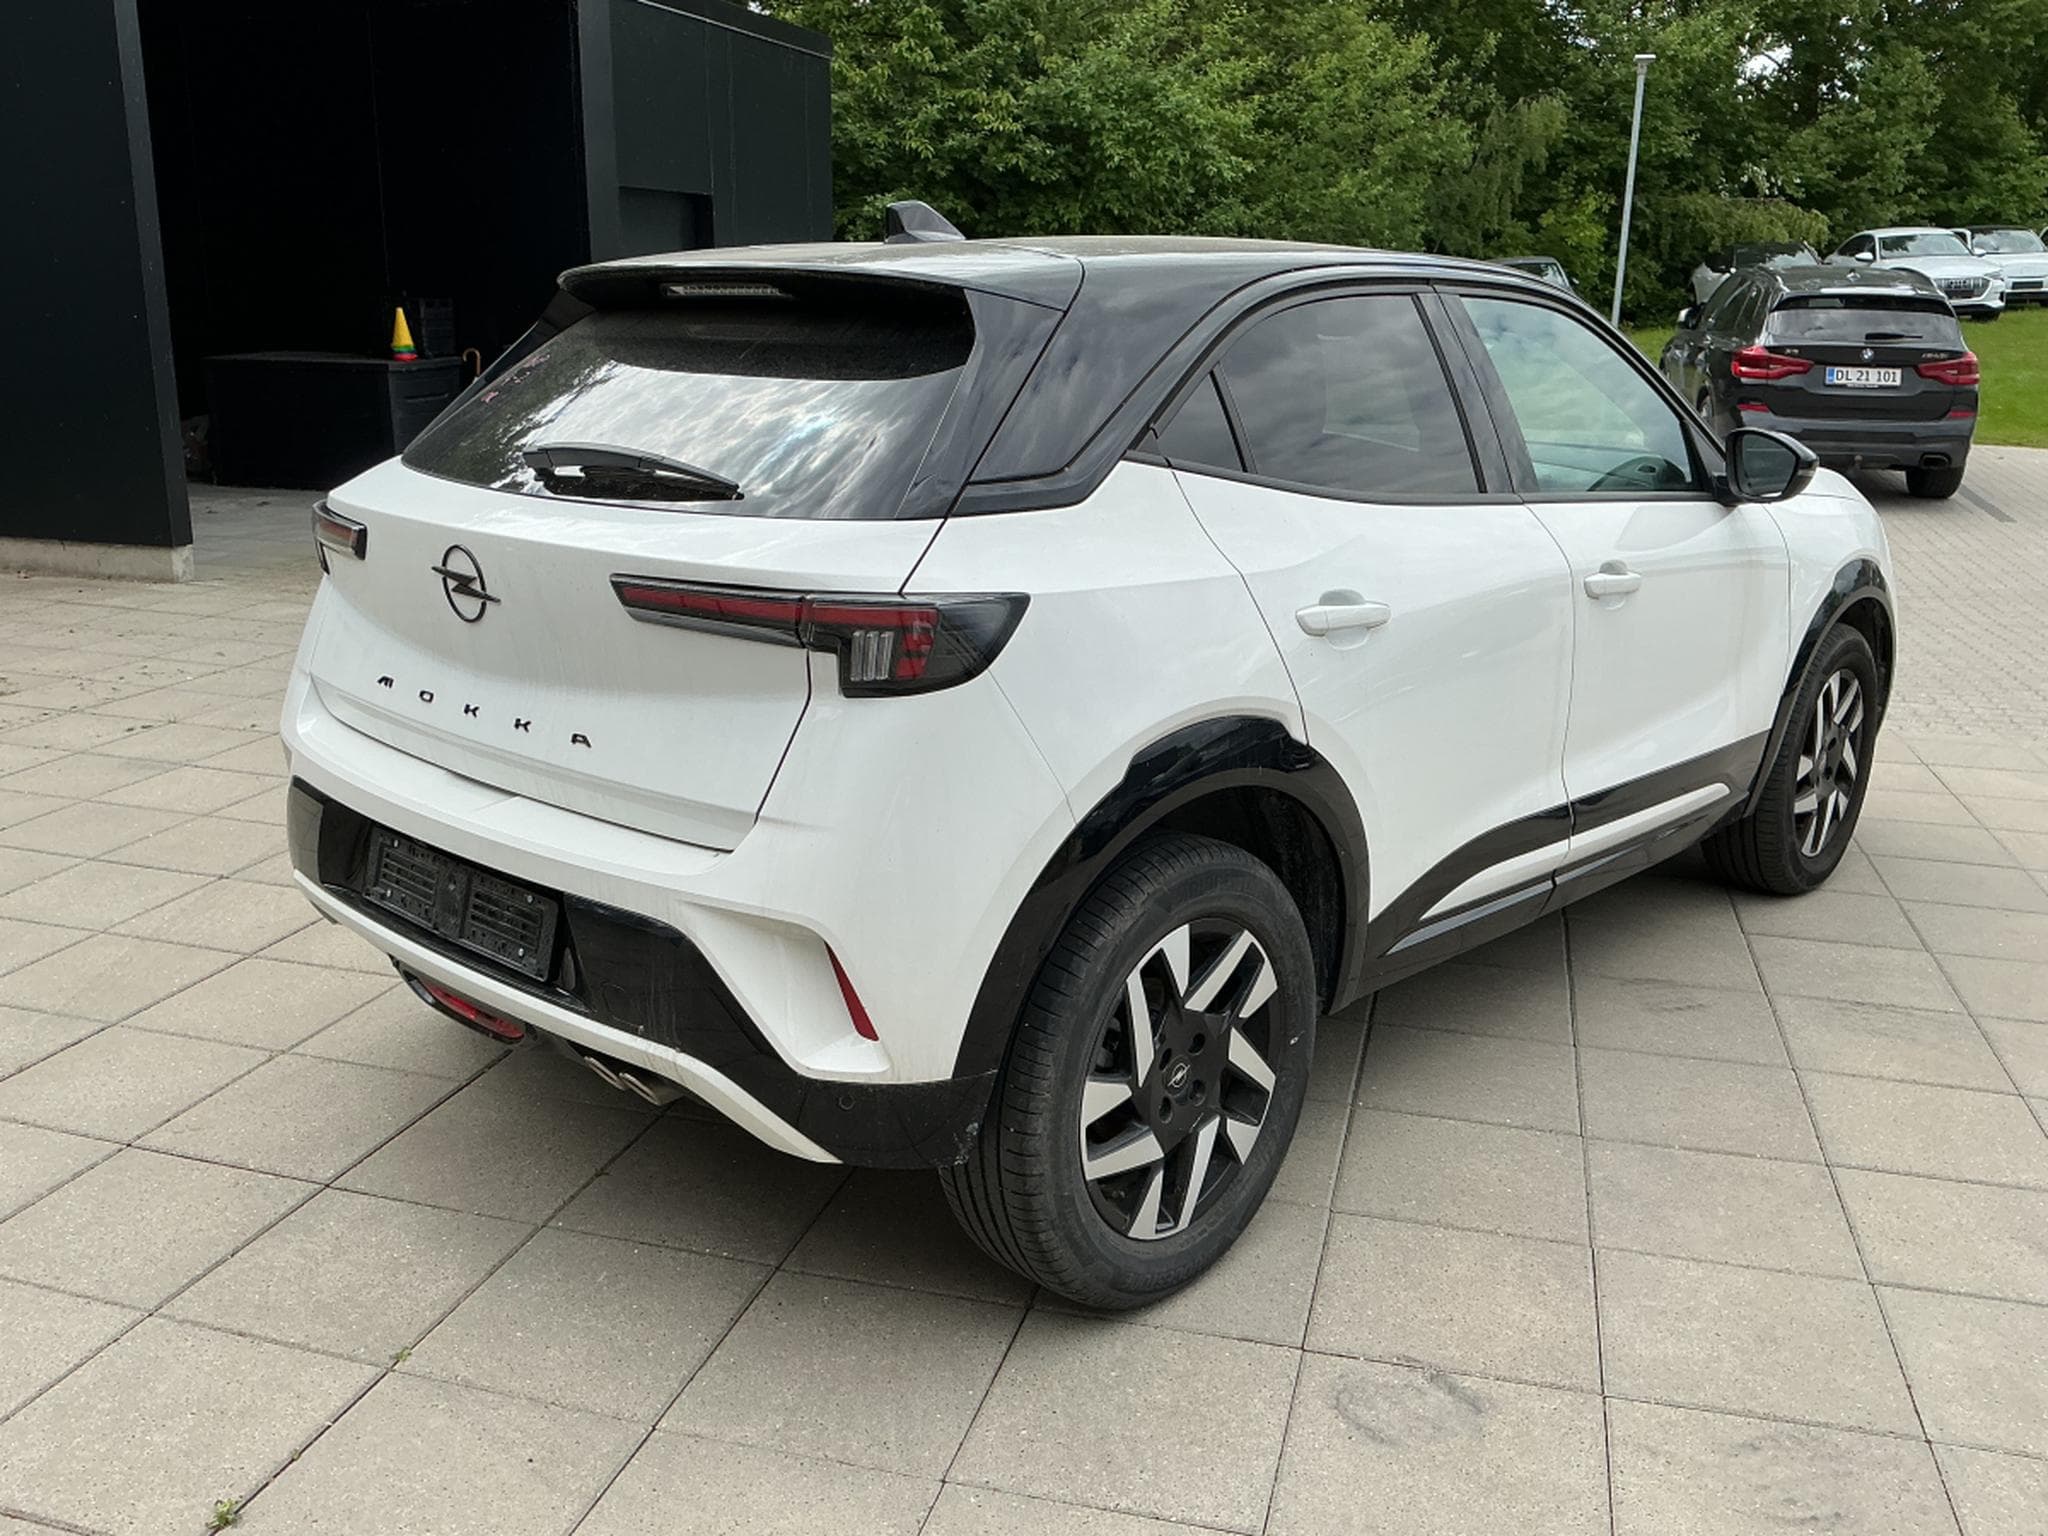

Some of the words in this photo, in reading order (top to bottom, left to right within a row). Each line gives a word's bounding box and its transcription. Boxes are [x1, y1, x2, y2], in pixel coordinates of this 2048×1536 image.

[1836, 369, 1852, 381] DL
[1856, 370, 1869, 382] 21
[1876, 371, 1897, 383] 101
[377, 675, 592, 748] MOKKA
